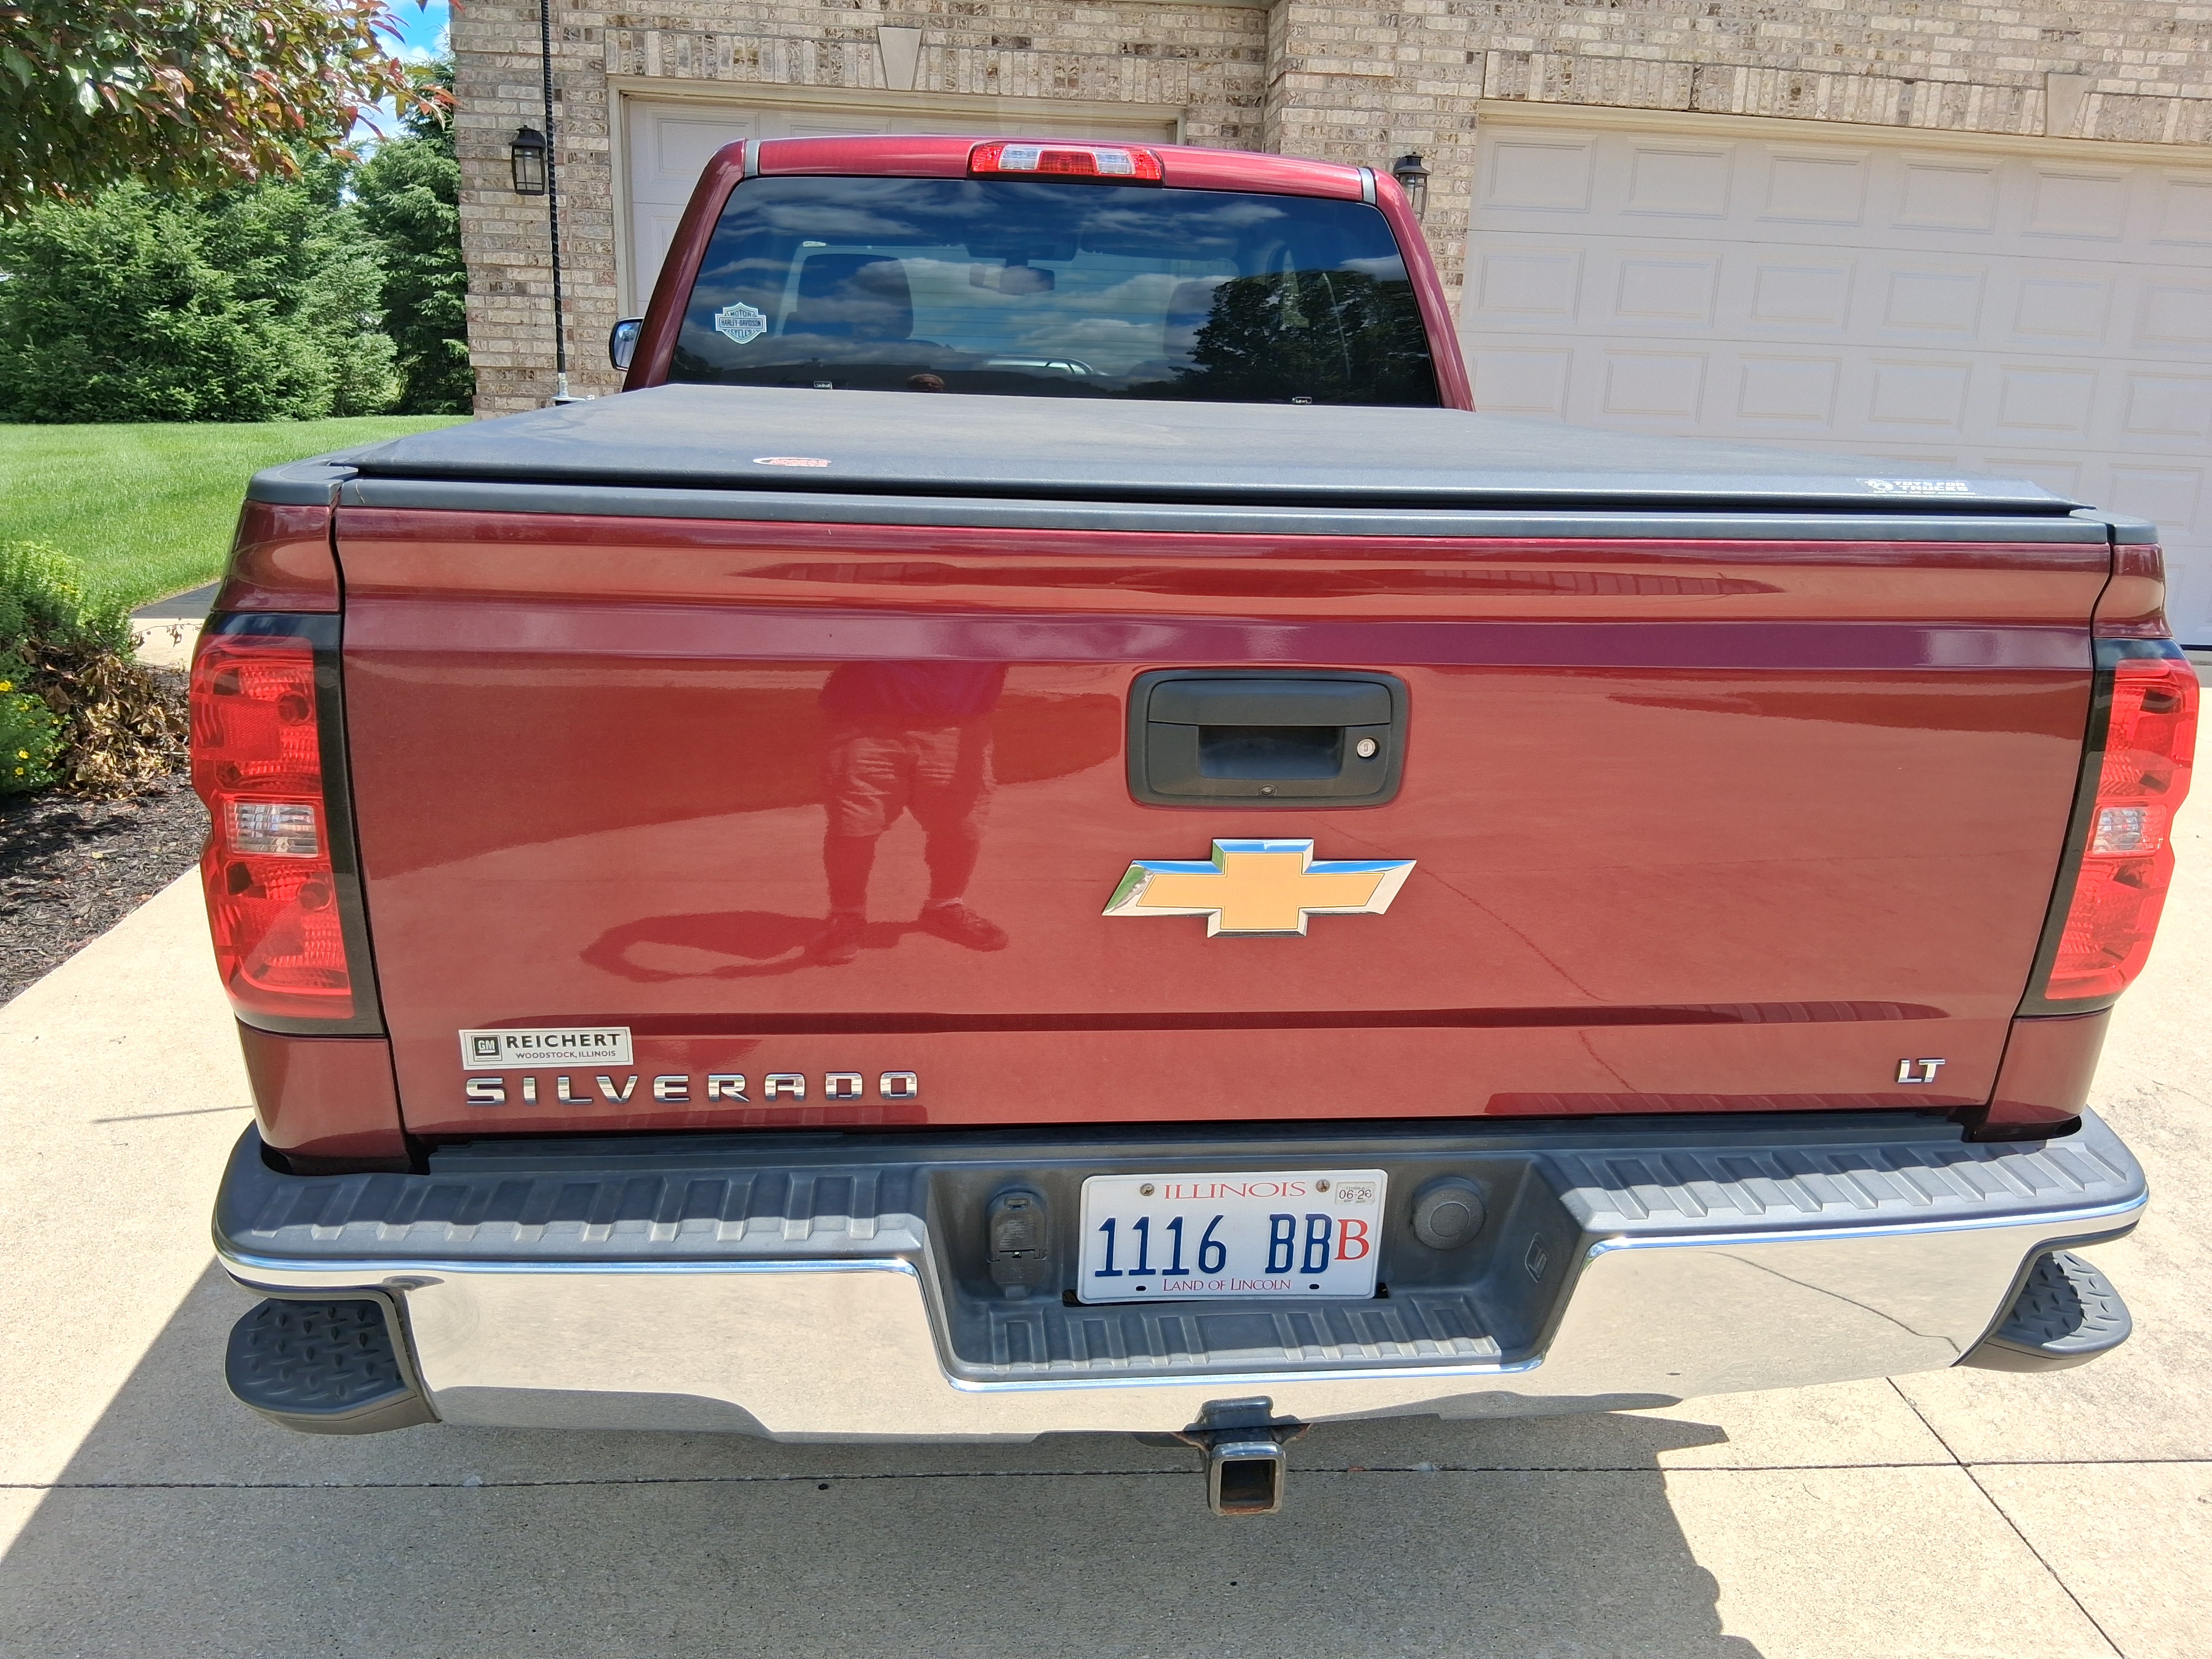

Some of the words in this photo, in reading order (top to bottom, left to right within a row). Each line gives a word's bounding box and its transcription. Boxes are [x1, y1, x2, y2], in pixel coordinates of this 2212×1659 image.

[730, 309, 751, 317] MOTOR
[730, 329, 753, 337] CYCLES
[478, 1040, 496, 1050] GM
[506, 1033, 621, 1049] REICHERT
[515, 1051, 577, 1059] WOODSTOCK,
[1896, 1058, 1946, 1083] LT
[466, 1071, 918, 1106] SILVERADO
[1163, 1181, 1306, 1200] ILLINOIS
[1339, 1189, 1372, 1200] 06-26
[1095, 1214, 1227, 1277] 1116
[1265, 1213, 1333, 1274] BB
[1230, 1278, 1291, 1291] LINCOLN
